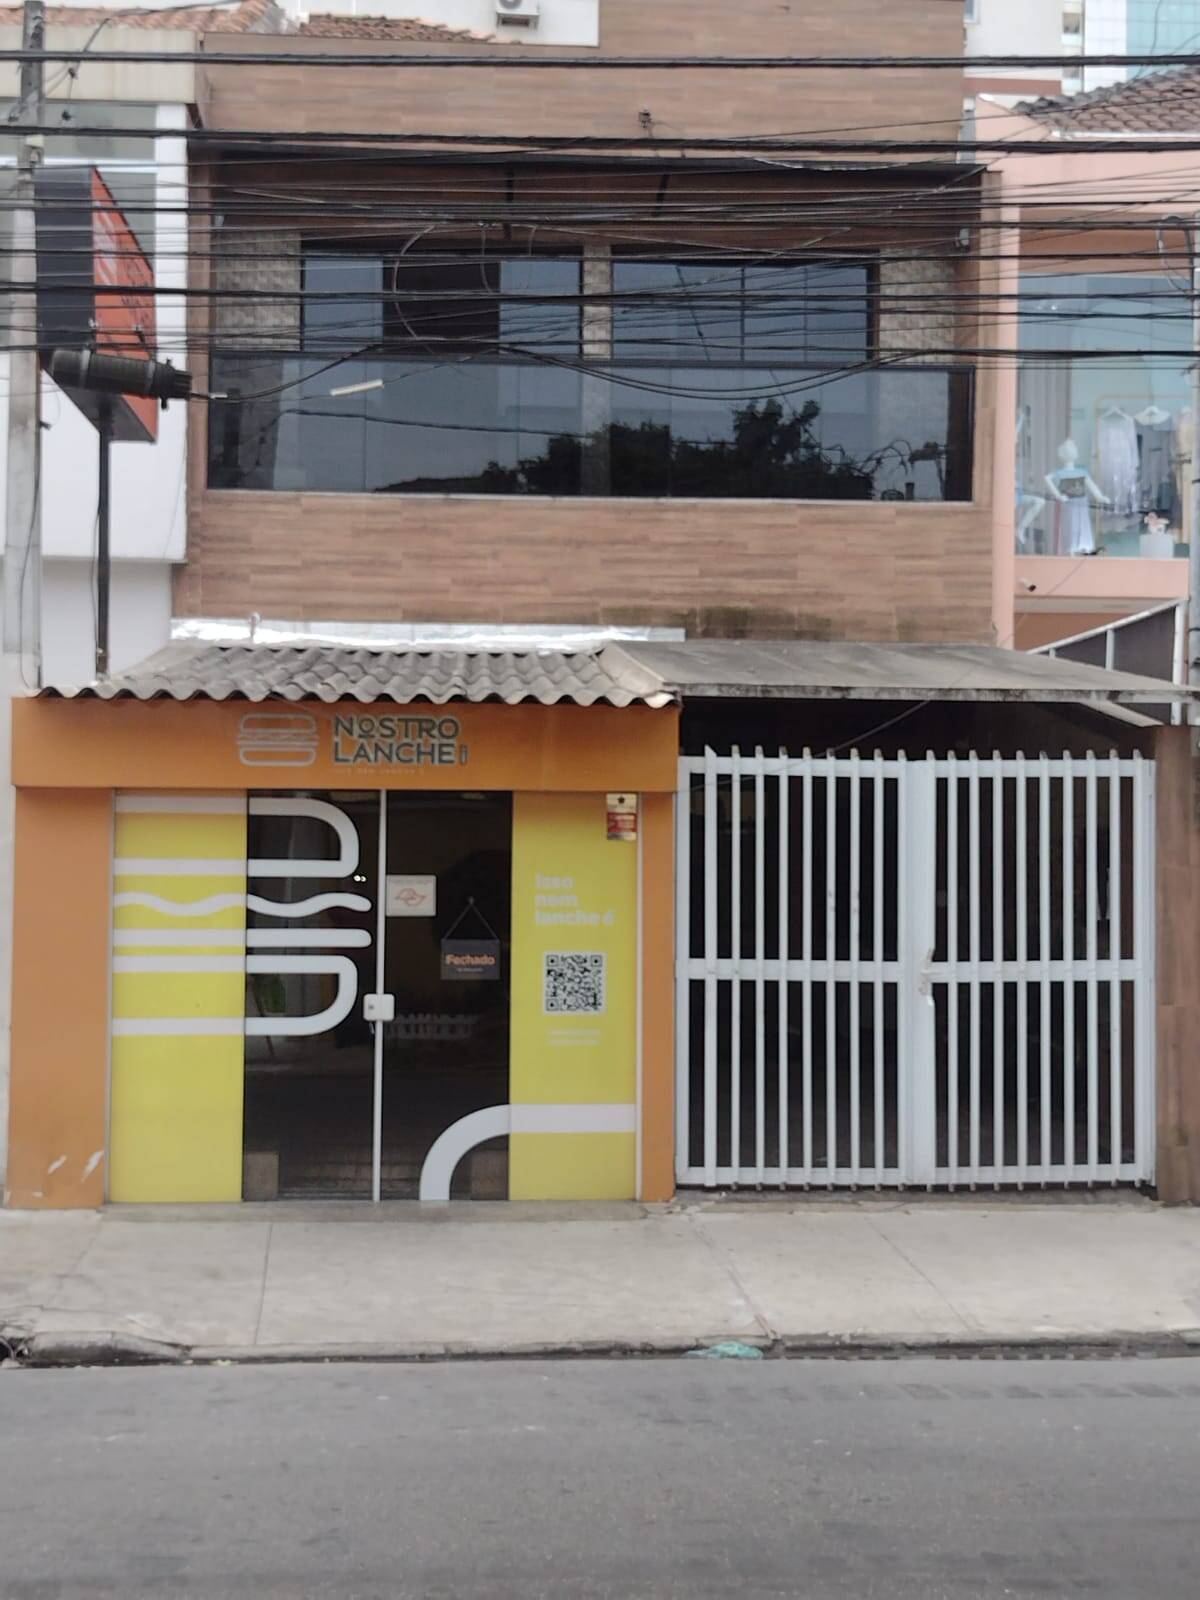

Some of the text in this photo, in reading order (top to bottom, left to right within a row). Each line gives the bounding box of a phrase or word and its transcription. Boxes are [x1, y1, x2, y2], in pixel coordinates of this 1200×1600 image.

[333, 714, 460, 740] NOSTRO
[333, 740, 457, 764] LANCHE
[445, 953, 496, 966] Fechado
